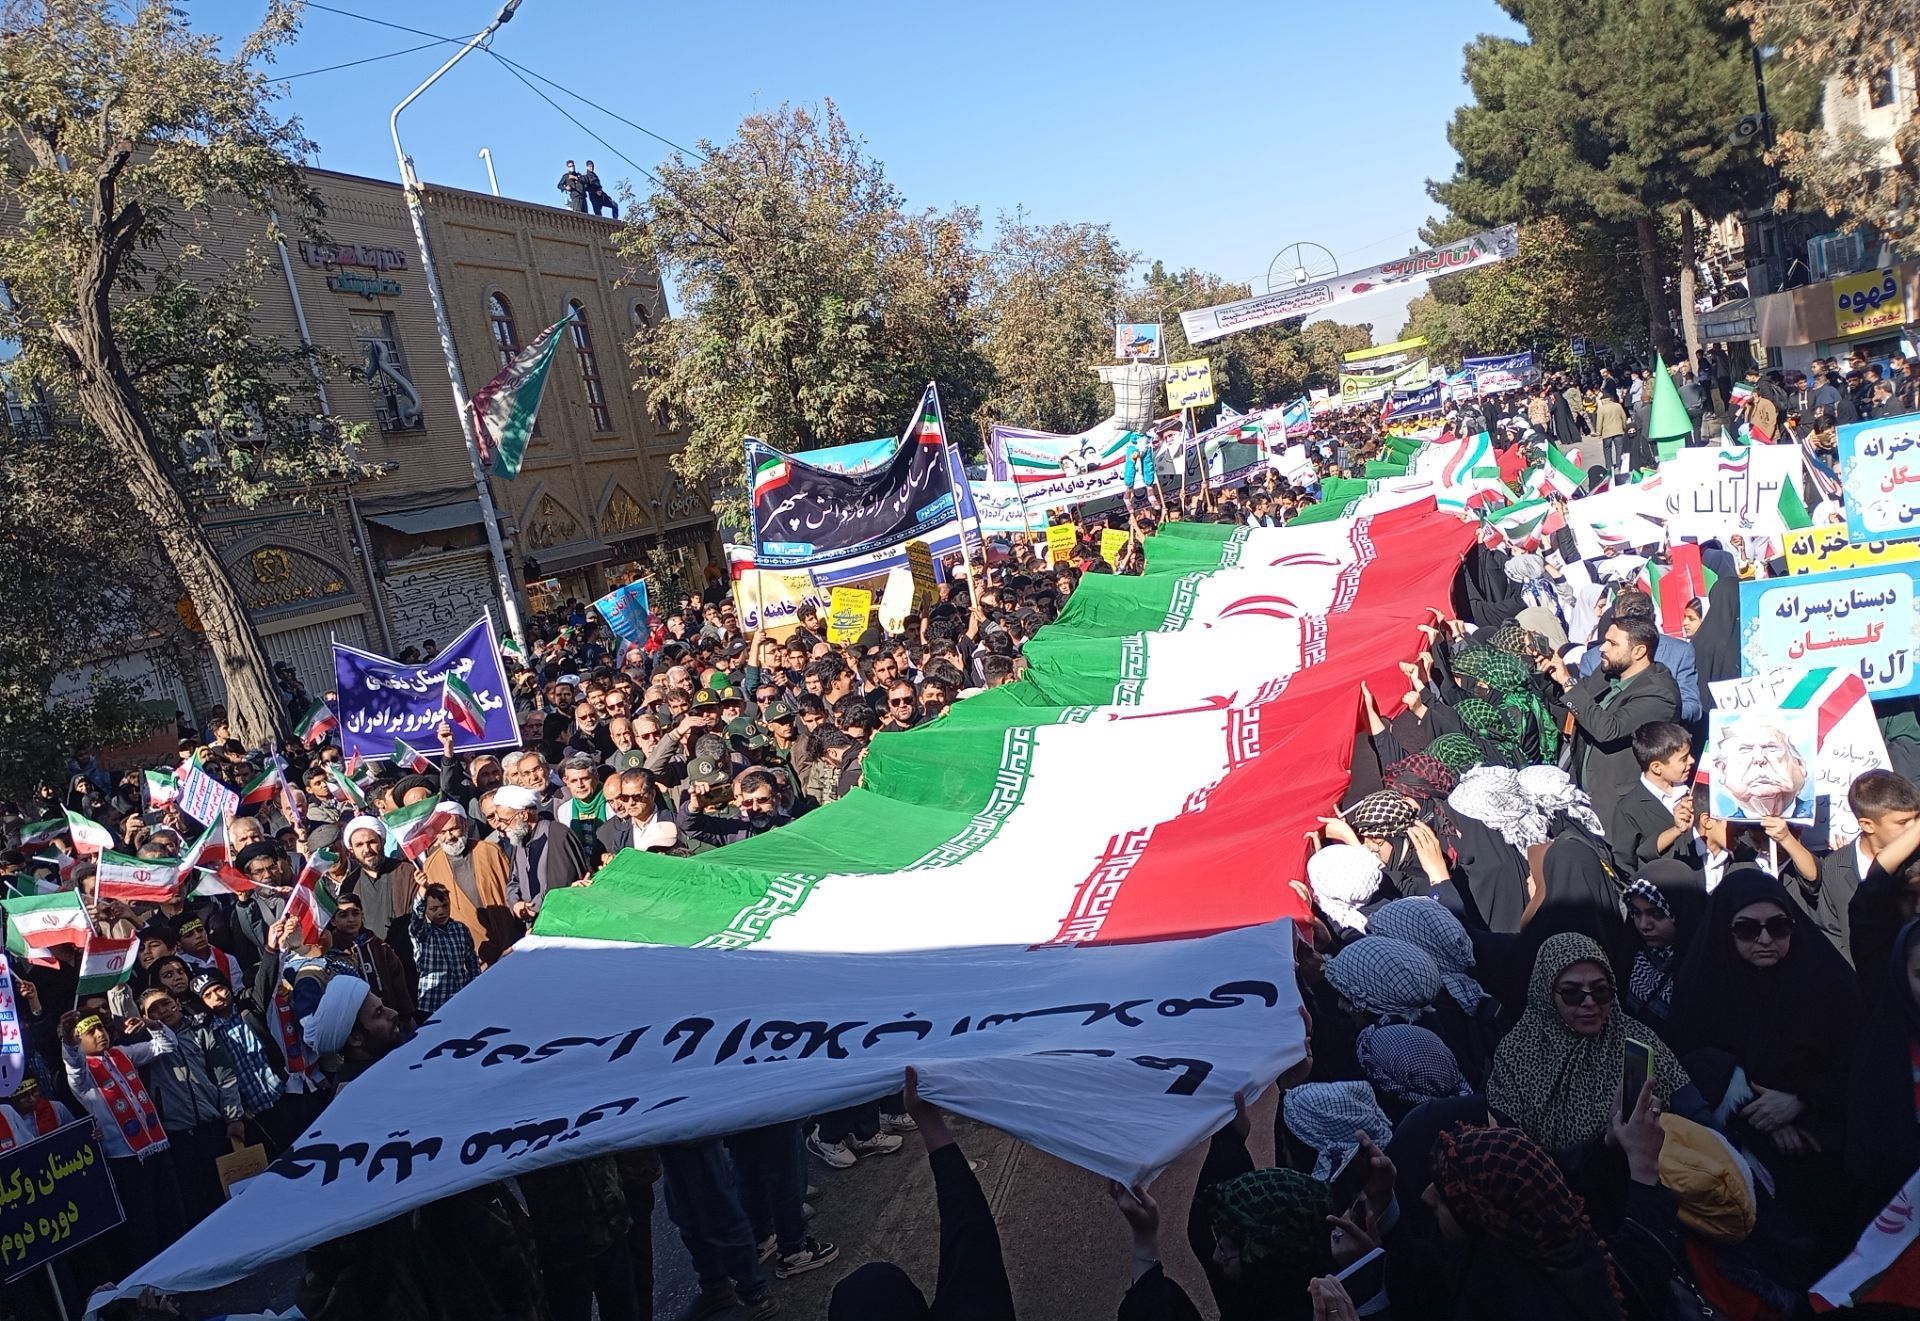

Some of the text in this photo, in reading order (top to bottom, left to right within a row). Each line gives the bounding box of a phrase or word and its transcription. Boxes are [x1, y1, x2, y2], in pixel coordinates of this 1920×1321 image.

[1838, 268, 1897, 313] قهوه
[1841, 312, 1900, 330] موجود است
[1167, 364, 1209, 384] هنرستان فنی
[1199, 386, 1211, 402] امام
[900, 446, 944, 502] هنرستان
[1050, 484, 1064, 497] امام
[1103, 471, 1120, 485] فنی
[760, 491, 809, 533] سپهر
[866, 475, 900, 518] پسرانه
[1022, 487, 1047, 504] خمینی
[1694, 473, 1746, 524] آبان
[1791, 529, 1861, 560] خترانه
[764, 601, 797, 618] خامنه
[1775, 588, 1897, 623] دبستان پسرانه
[1788, 621, 1885, 660] گلستان
[1879, 648, 1908, 684] آل
[1720, 679, 1756, 710] آبان
[347, 706, 404, 734] برادران
[193, 974, 208, 993] GAP
[662, 1013, 715, 1064] با
[715, 1011, 932, 1066] انقلاب
[951, 980, 1279, 1037] اسلامی
[38, 1143, 94, 1196] دبستان
[267, 1130, 444, 1187] جدید
[1, 1200, 79, 1265] دوره دوم
